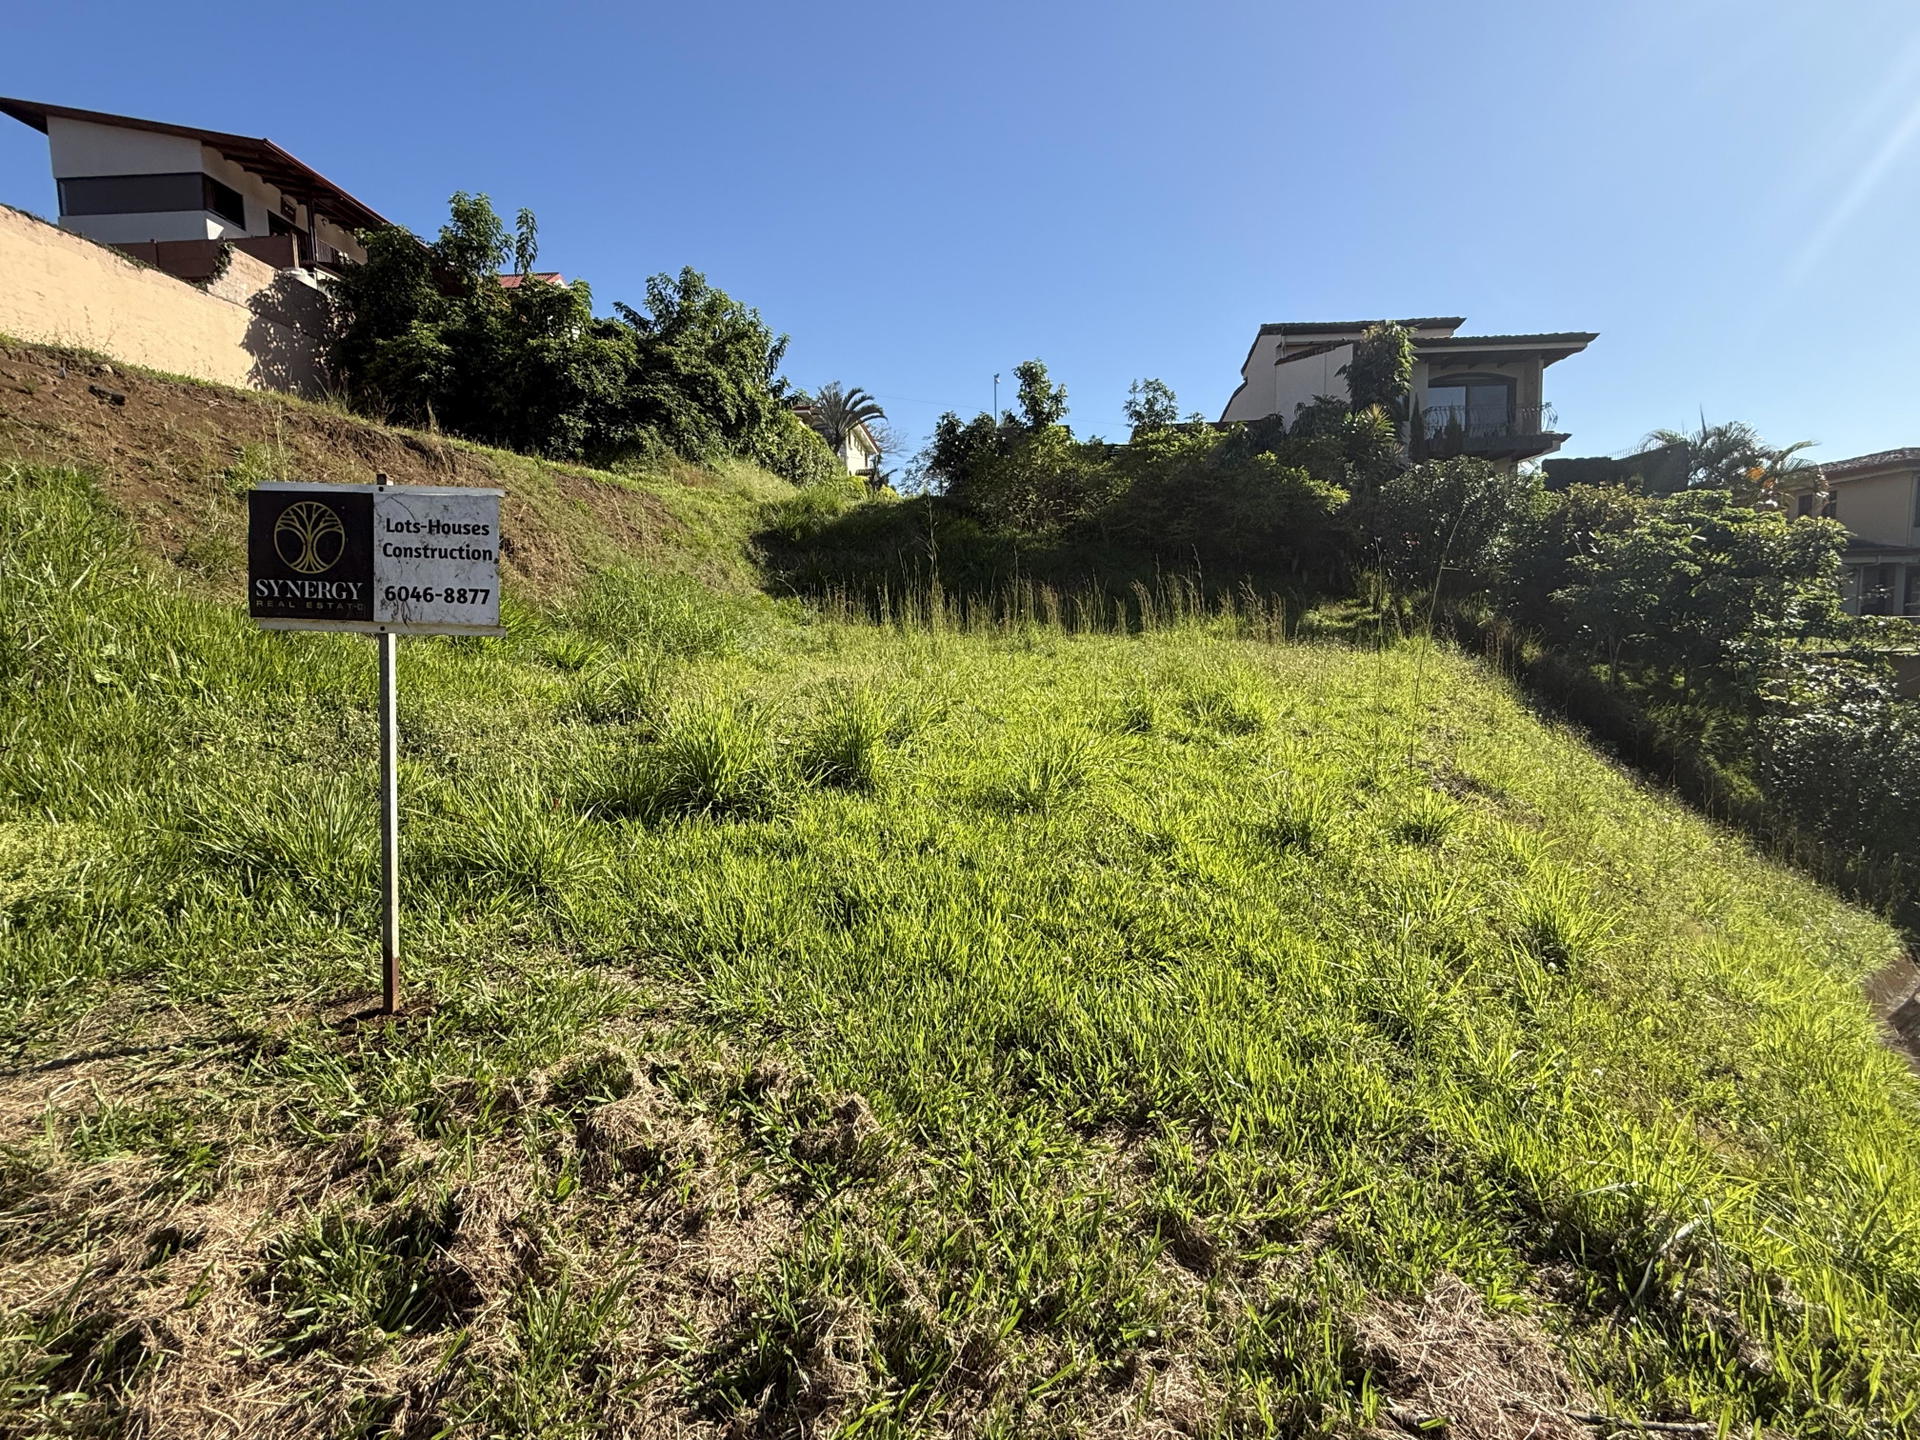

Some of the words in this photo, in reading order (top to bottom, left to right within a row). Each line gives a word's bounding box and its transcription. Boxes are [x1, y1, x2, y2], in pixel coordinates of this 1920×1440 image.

[386, 518, 490, 536] Lots-Houses
[383, 542, 493, 561] Construction
[256, 579, 363, 600] SYNERGY
[385, 586, 490, 605] 6046-8877
[256, 600, 296, 608] REAL
